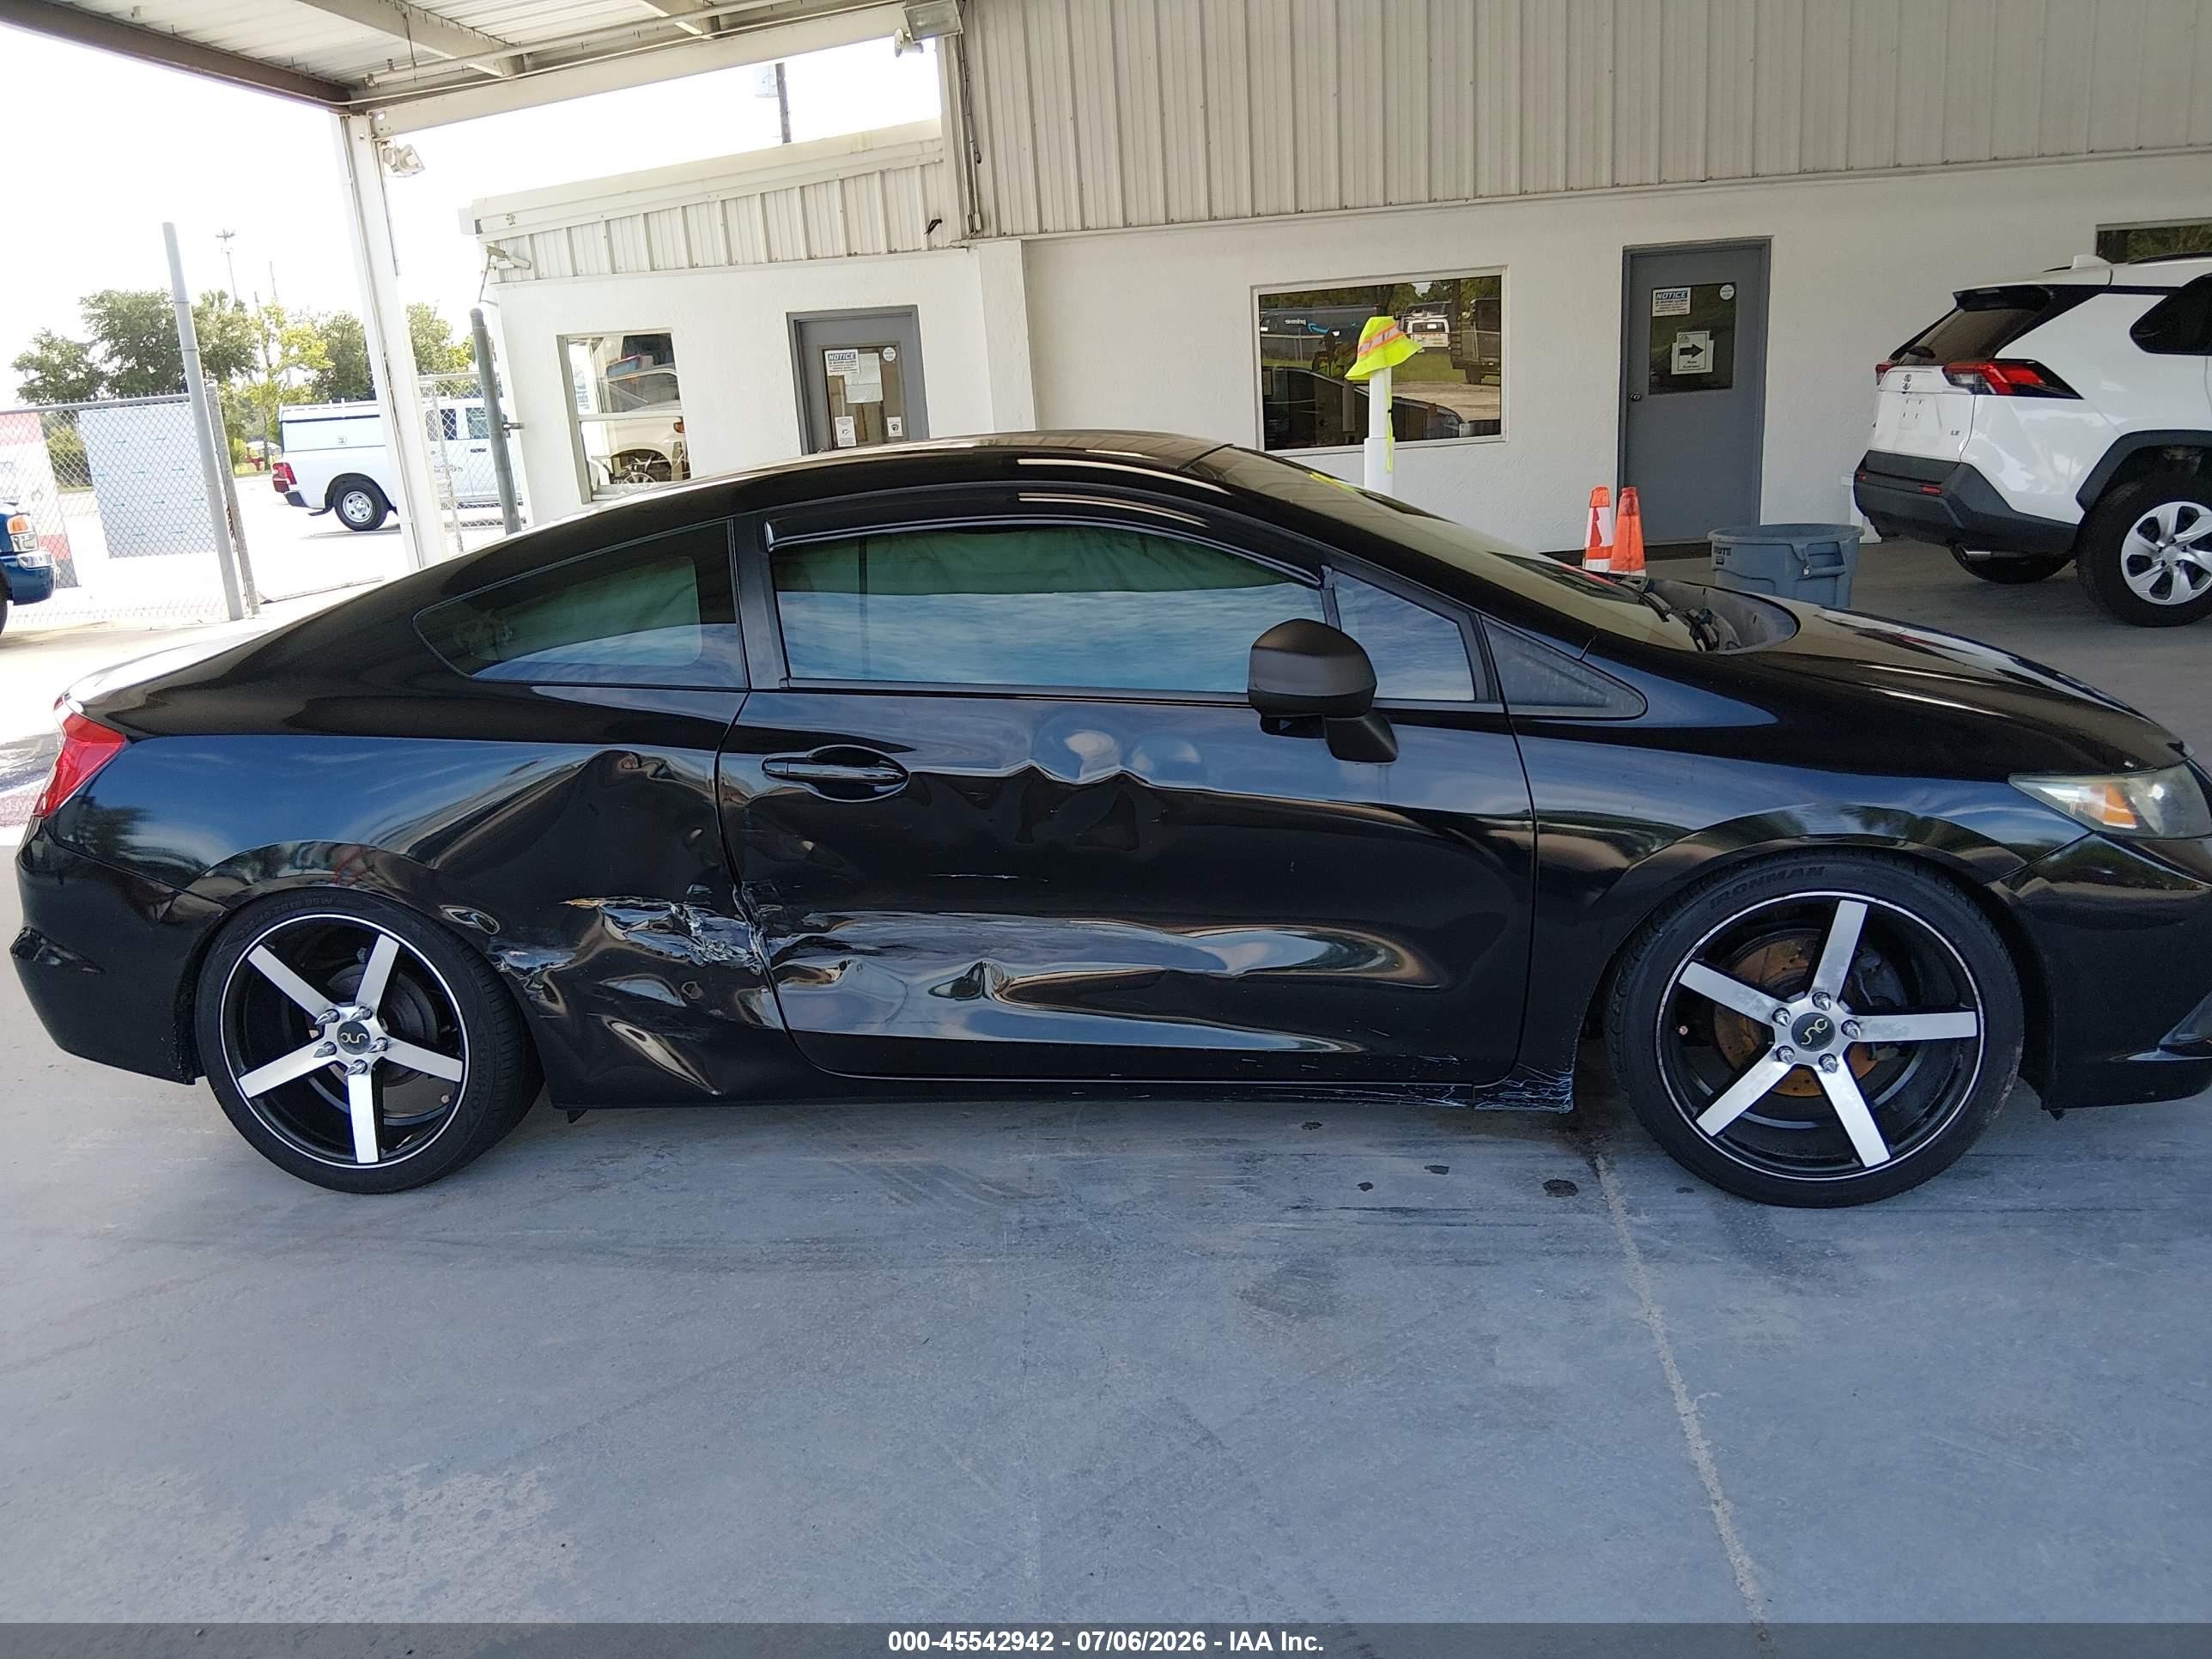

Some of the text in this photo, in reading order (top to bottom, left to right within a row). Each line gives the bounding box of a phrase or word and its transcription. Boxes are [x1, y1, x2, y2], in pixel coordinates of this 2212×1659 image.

[1656, 291, 1687, 300] NOTICE
[829, 352, 855, 361] NOTICE
[1710, 865, 1827, 910] IRONMAN
